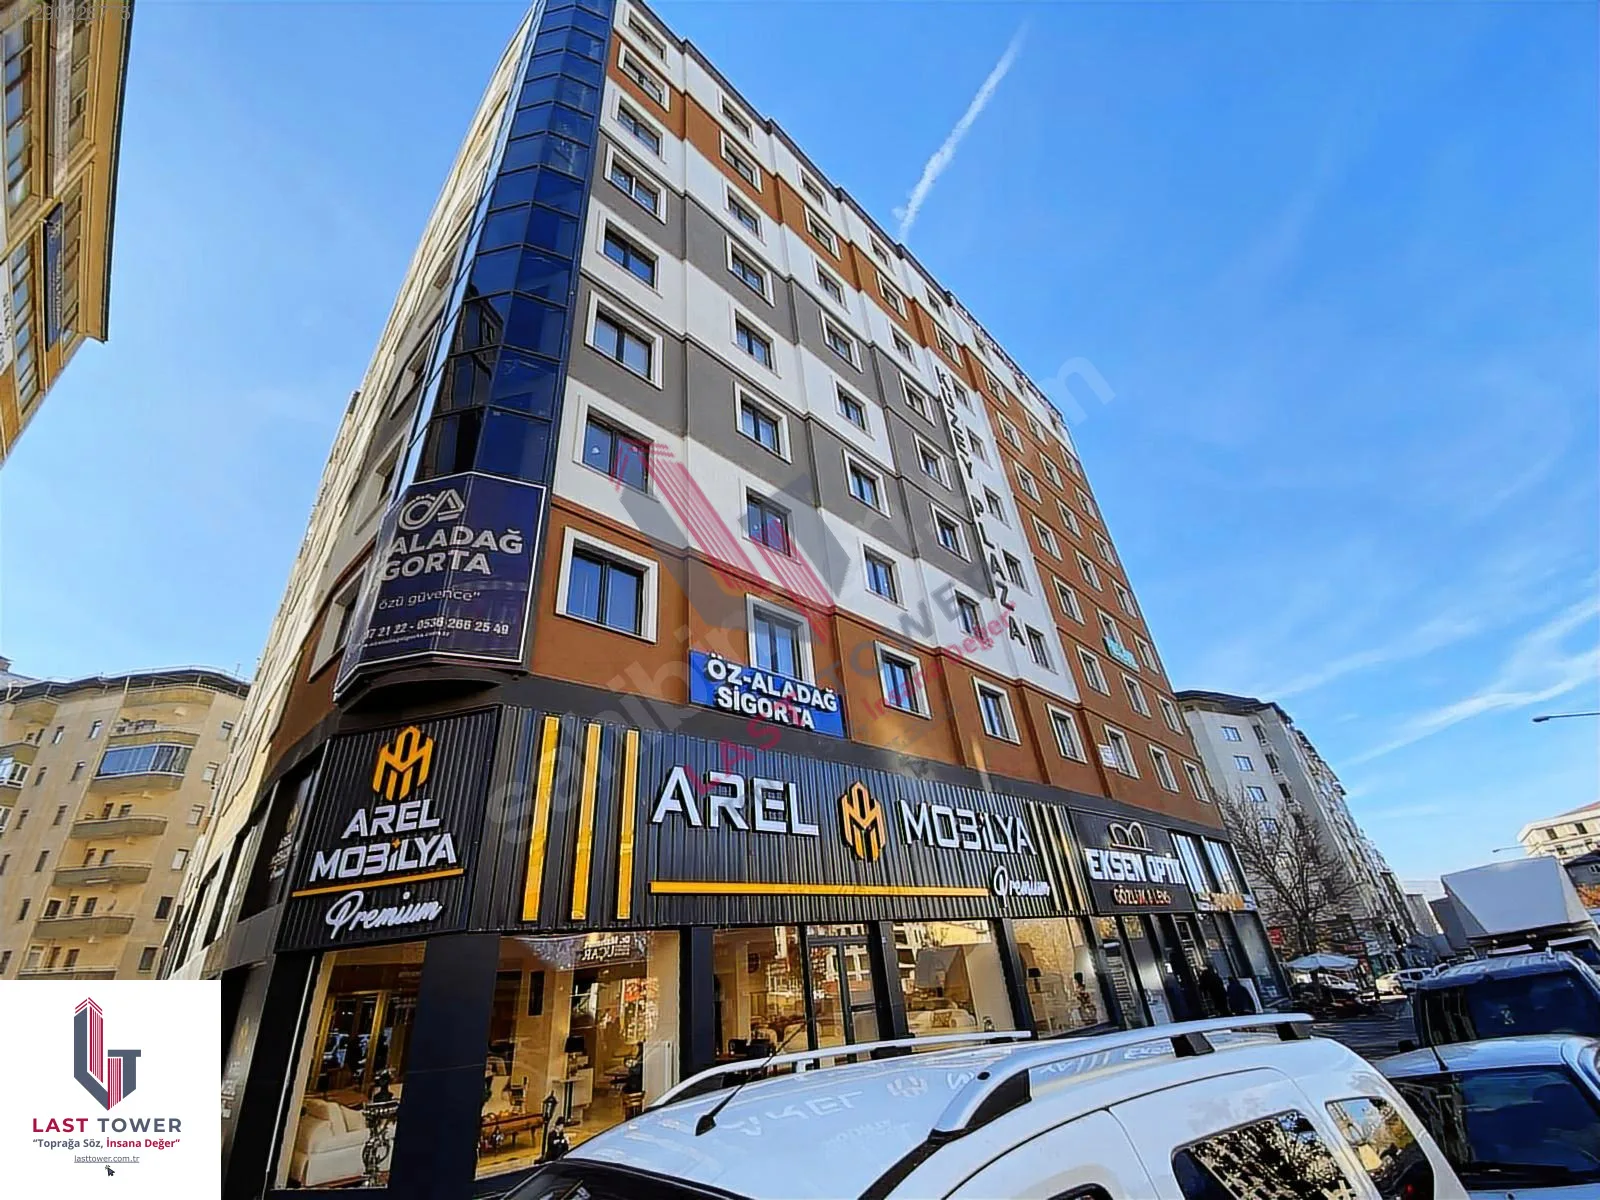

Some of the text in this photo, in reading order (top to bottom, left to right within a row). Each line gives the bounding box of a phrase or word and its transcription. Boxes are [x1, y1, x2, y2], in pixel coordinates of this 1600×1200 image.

[935, 365, 1026, 647] KUZEY PLAZA
[390, 525, 523, 555] ALADAĞ
[493, 623, 510, 635] 49
[707, 652, 838, 712] ÖZ-ALADAĞ
[717, 686, 815, 730] SİGORTA
[340, 798, 441, 840] AREL
[651, 765, 820, 837] AREL
[1084, 847, 1147, 882] EKSEN
[325, 890, 443, 939] Premium
